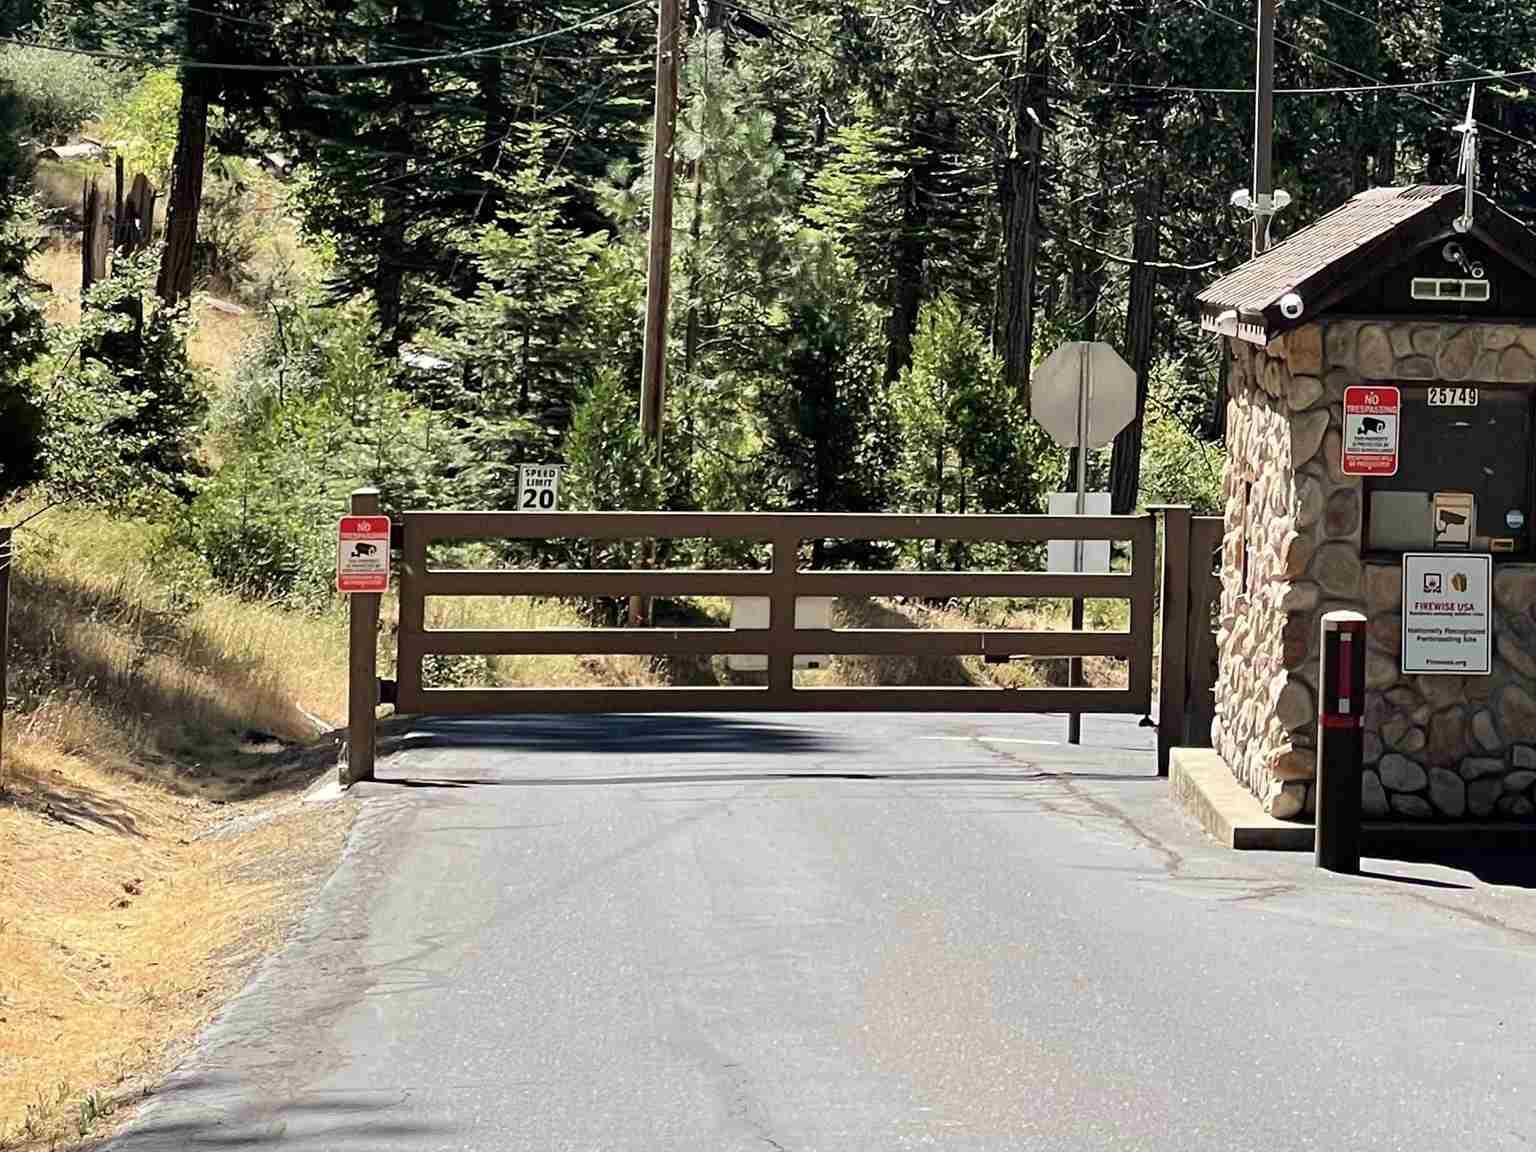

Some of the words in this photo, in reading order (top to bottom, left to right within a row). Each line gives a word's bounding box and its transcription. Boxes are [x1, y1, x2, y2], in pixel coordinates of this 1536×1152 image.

[1364, 394, 1380, 405] NO
[1430, 388, 1477, 404] 25749
[525, 469, 556, 478] SPEED
[526, 478, 553, 487] LIMIT
[523, 489, 554, 508] 20
[1457, 603, 1474, 612] USA
